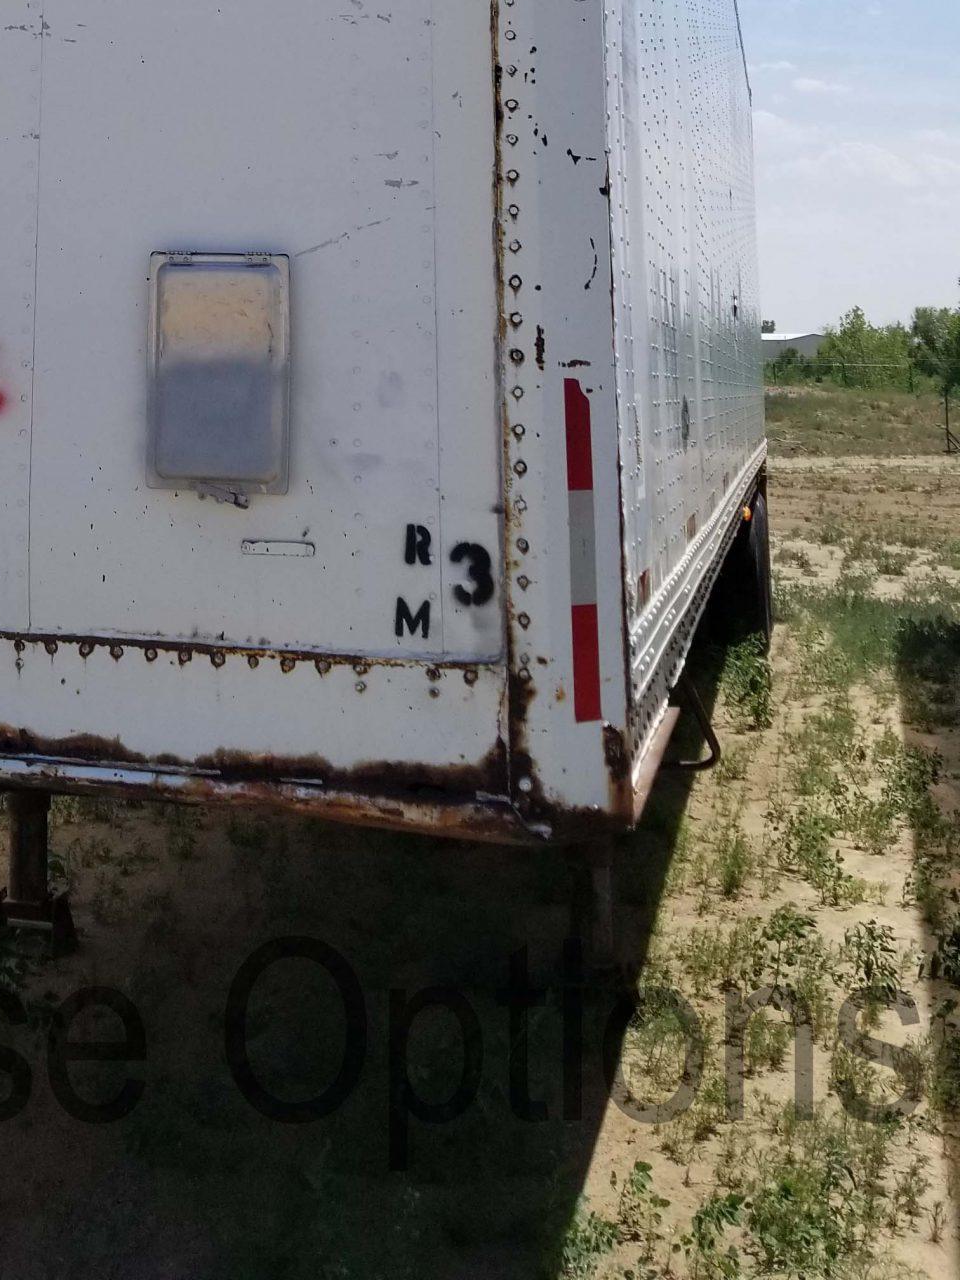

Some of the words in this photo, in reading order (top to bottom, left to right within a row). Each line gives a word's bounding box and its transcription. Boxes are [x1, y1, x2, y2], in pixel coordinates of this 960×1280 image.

[404, 523, 432, 565] R
[449, 541, 495, 606] 3
[395, 596, 430, 639] M
